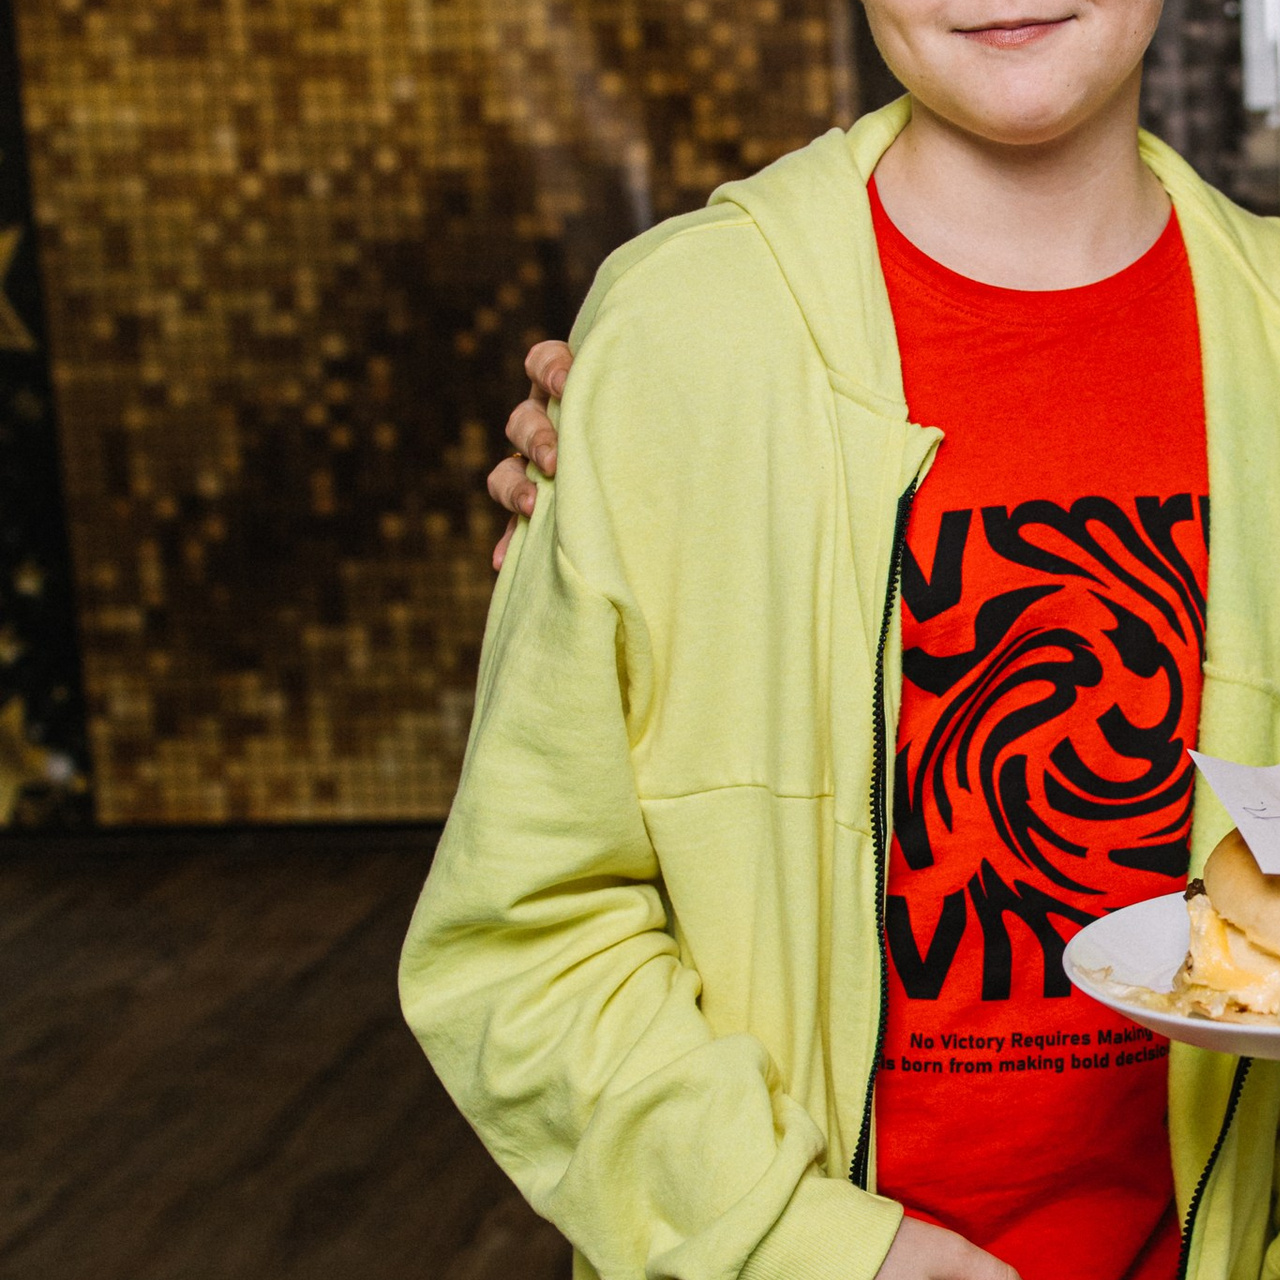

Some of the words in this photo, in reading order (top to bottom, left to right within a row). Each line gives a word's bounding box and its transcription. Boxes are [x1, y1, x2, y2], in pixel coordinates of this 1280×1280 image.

[910, 1032, 935, 1050] No
[941, 1033, 1005, 1053] Victory
[1011, 1030, 1091, 1050] Requires
[901, 1055, 943, 1073] born
[949, 1057, 996, 1073] from
[999, 1053, 1065, 1073] making
[1071, 1052, 1110, 1069] bold
